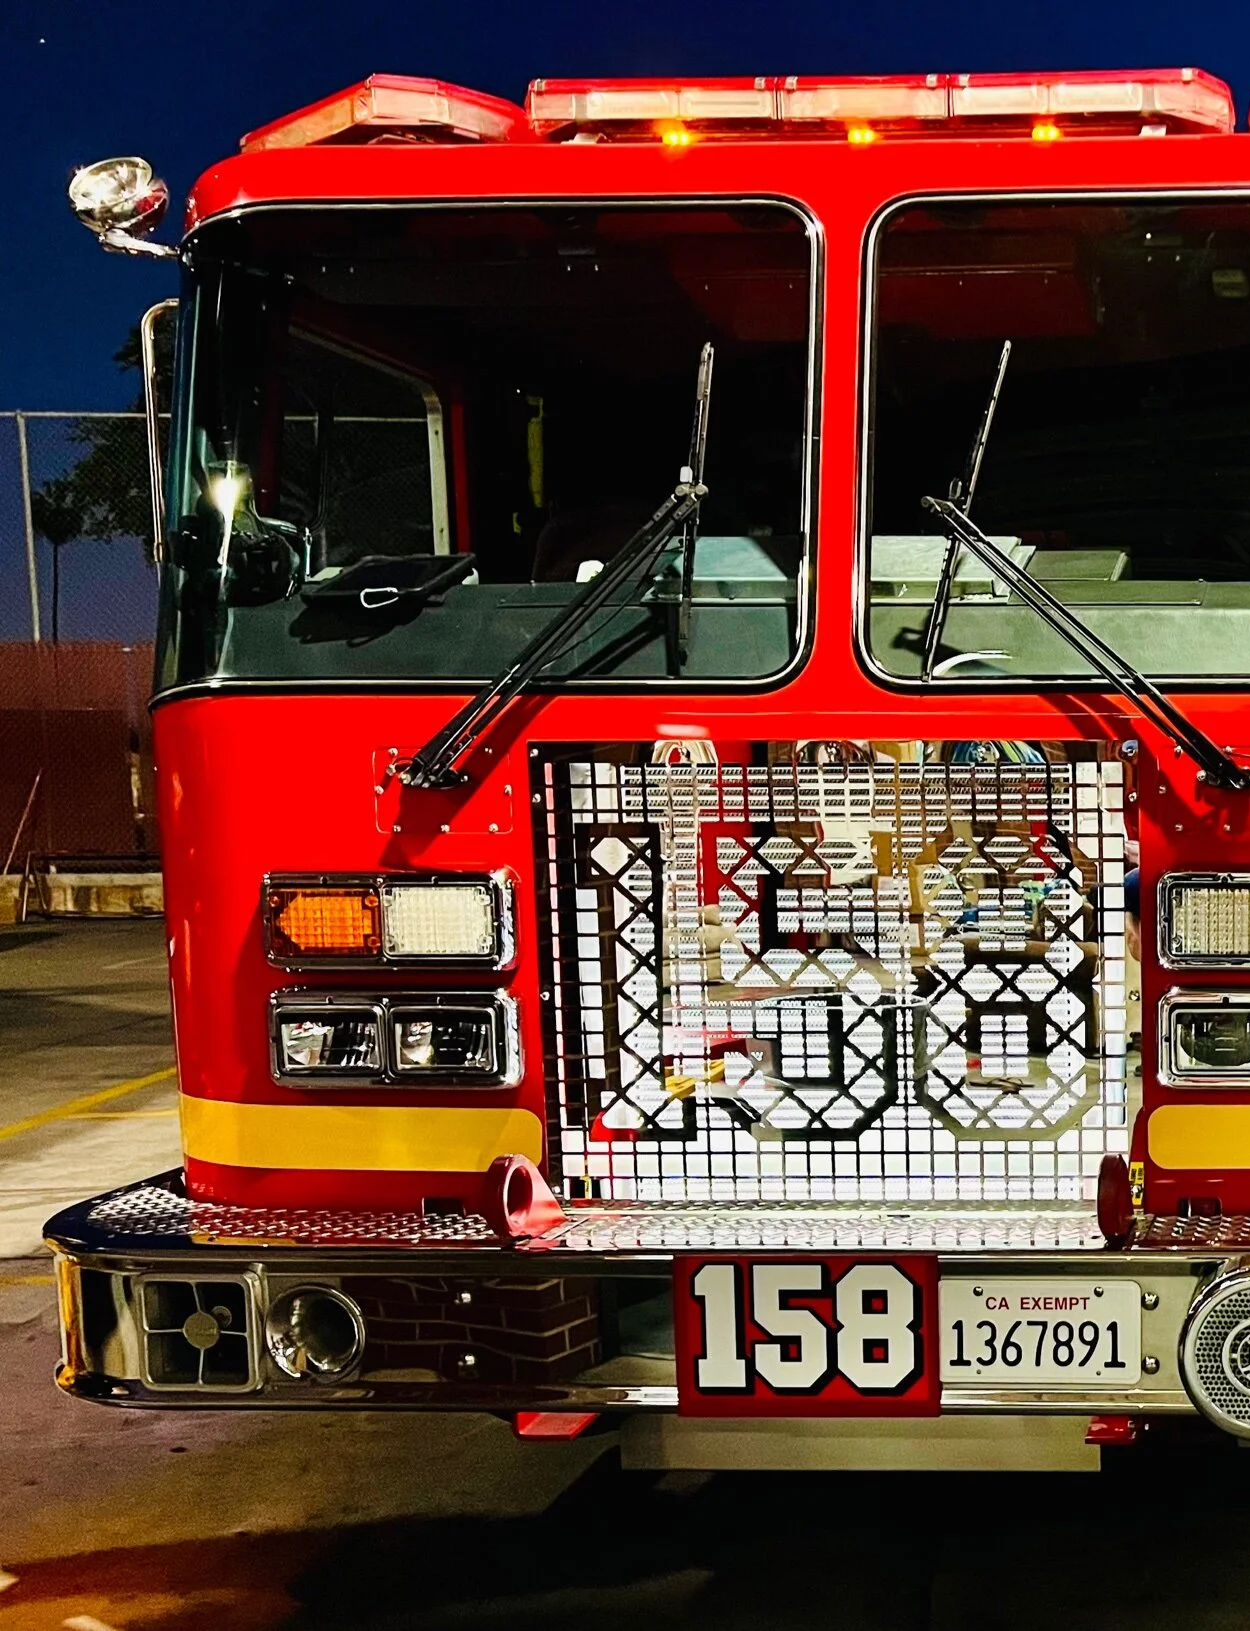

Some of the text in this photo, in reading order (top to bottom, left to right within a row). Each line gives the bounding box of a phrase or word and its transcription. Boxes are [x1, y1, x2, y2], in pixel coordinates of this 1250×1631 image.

[574, 821, 1100, 1141] 158
[692, 1264, 921, 1394] 158
[949, 1319, 1127, 1369] 1367891
[985, 1296, 1090, 1311] CA EXEMPT
